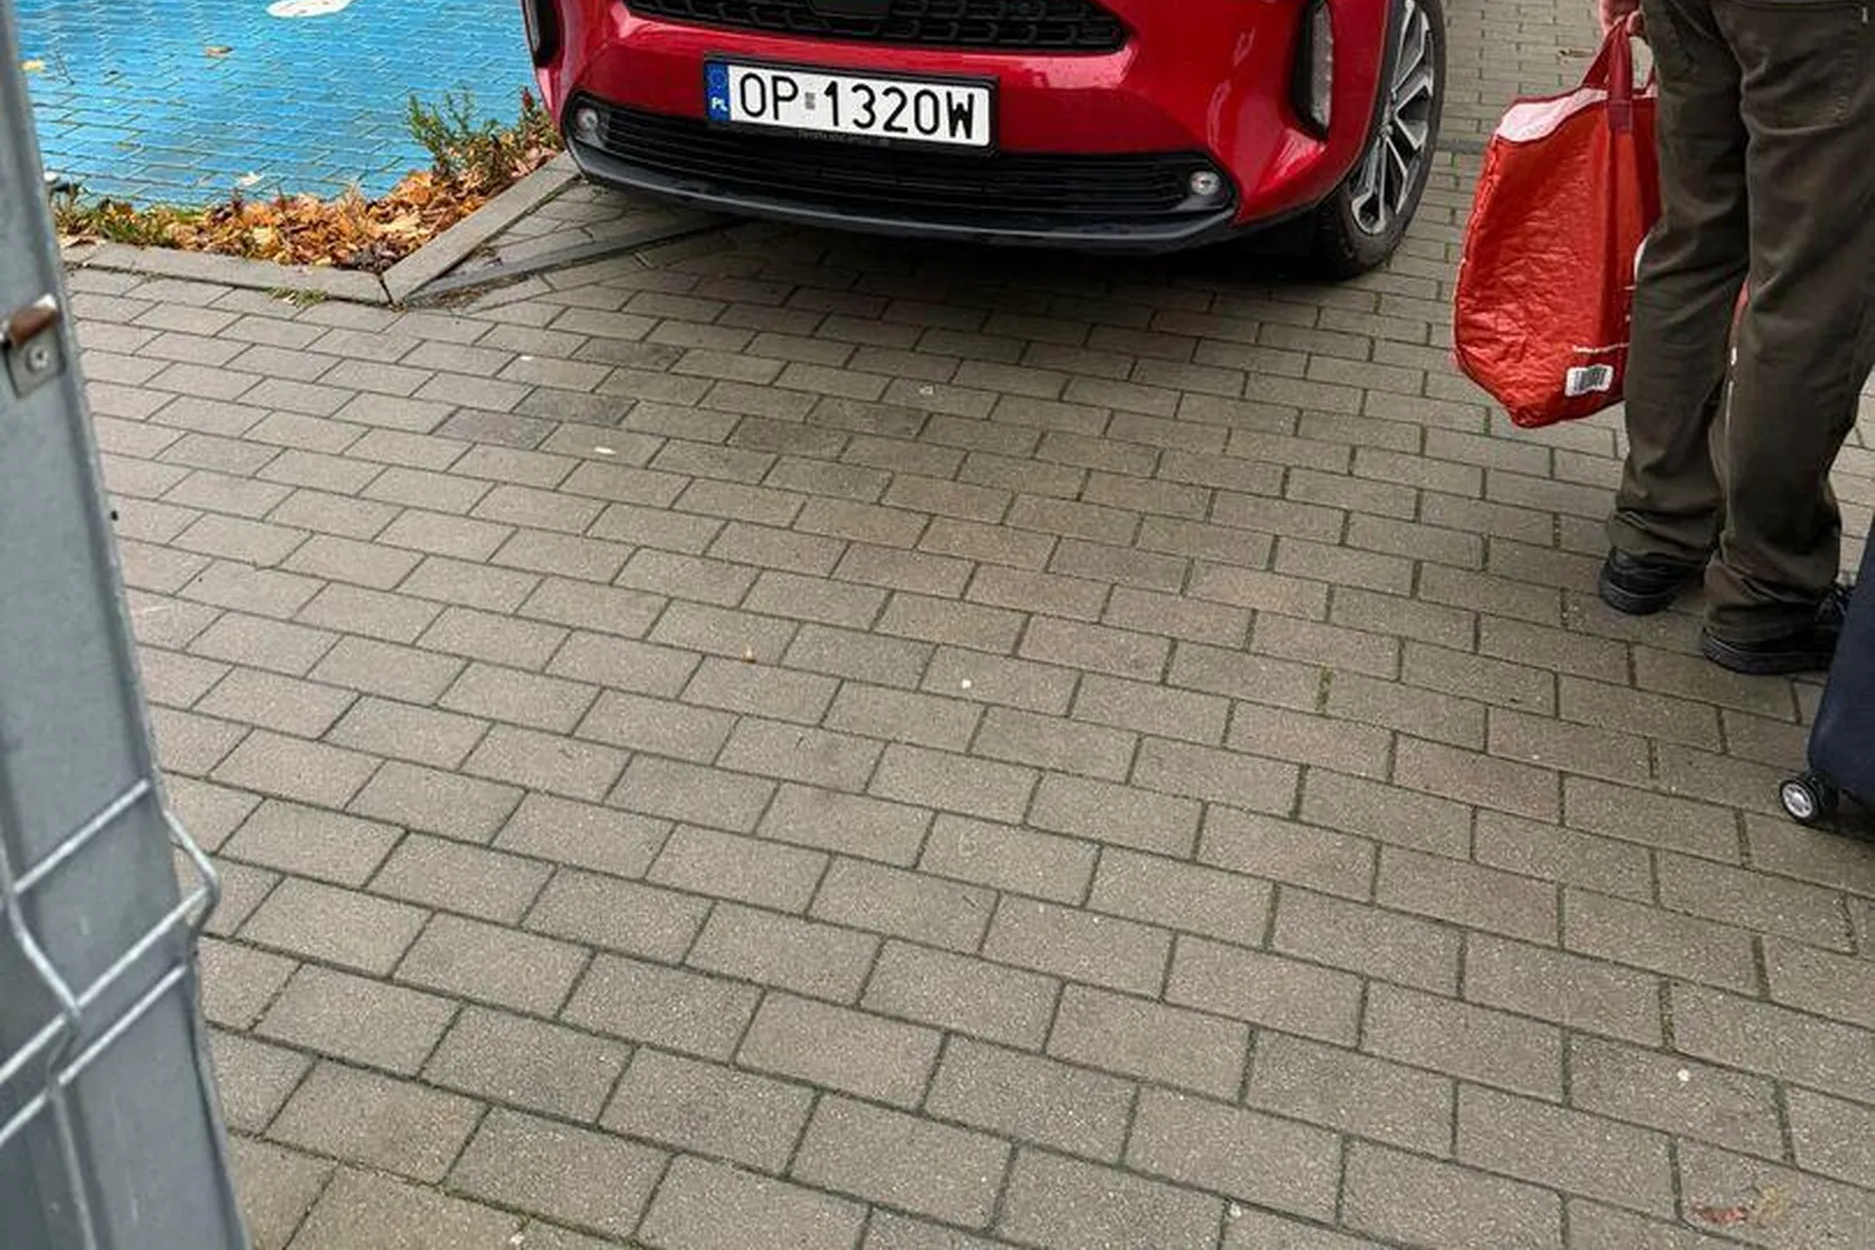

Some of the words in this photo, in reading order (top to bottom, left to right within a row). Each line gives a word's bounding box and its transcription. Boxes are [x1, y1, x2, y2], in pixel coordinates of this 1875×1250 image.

[711, 97, 728, 111] PL
[740, 73, 799, 121] OP
[824, 80, 975, 140] 1320W
